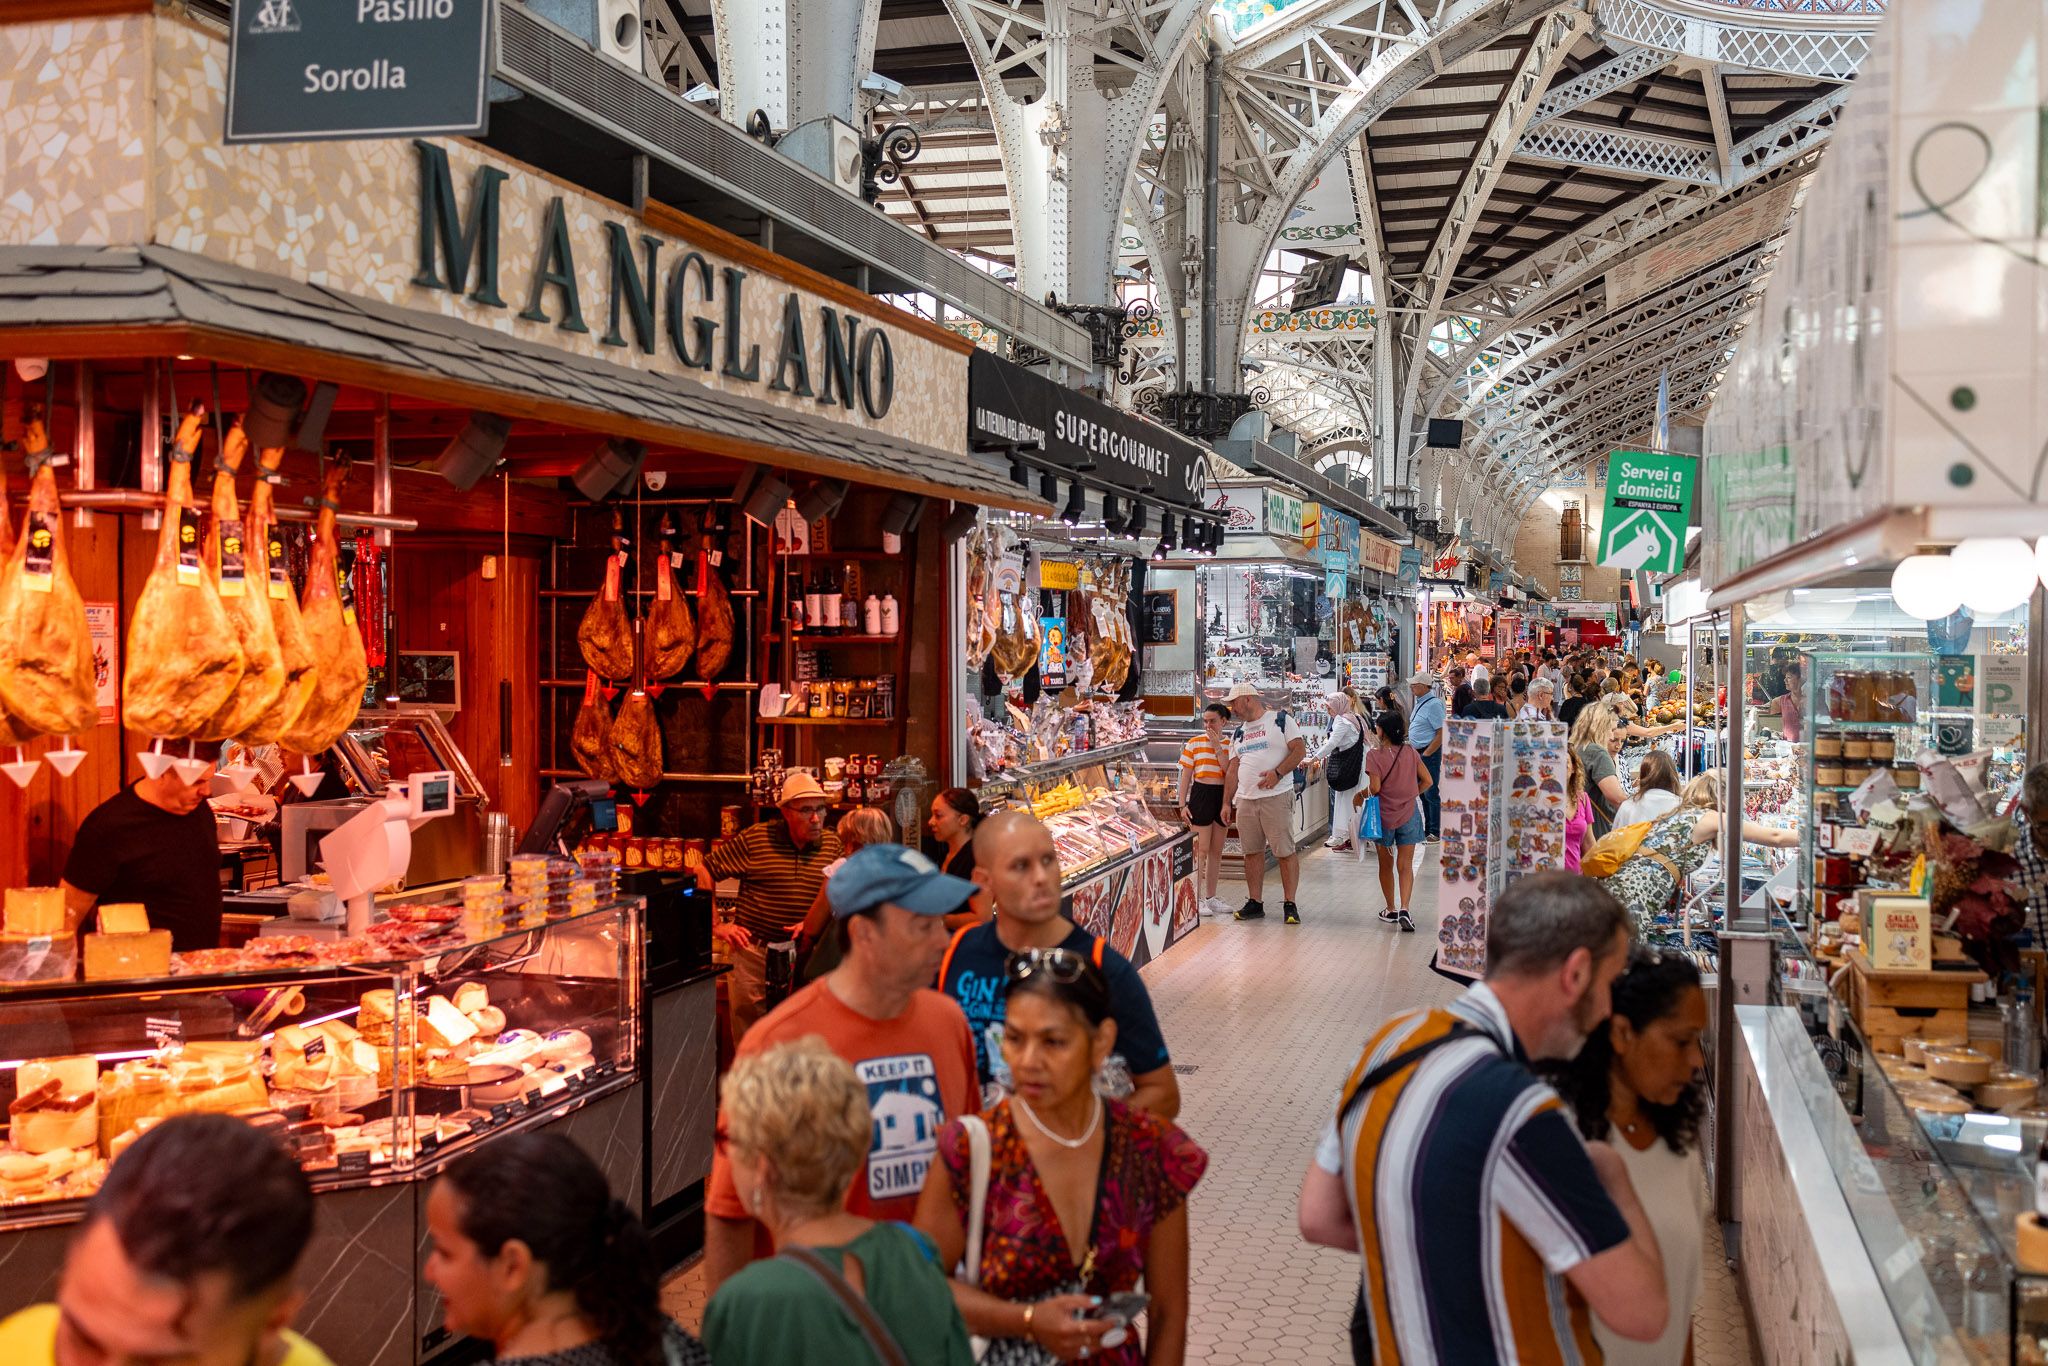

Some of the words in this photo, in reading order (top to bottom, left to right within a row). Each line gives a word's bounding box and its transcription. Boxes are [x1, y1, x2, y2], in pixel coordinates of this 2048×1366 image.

[357, 0, 454, 24] Pasillo
[304, 59, 406, 93] Sorolla
[411, 138, 895, 420] MANGLANO
[976, 406, 987, 431] LA
[987, 410, 1007, 438] TIENDA
[1007, 417, 1019, 443] DEL
[1055, 410, 1170, 477] SUPERGOURMET
[1621, 462, 1669, 481] Servei
[1672, 471, 1682, 482] a
[1618, 480, 1681, 500] domicili
[1628, 500, 1651, 509] ESPANYA
[1656, 502, 1678, 511] EUROPA
[957, 968, 998, 1004] GIN
[864, 1061, 909, 1079] KEEP
[913, 1060, 925, 1072] IT
[873, 1161, 929, 1192] SIMP
